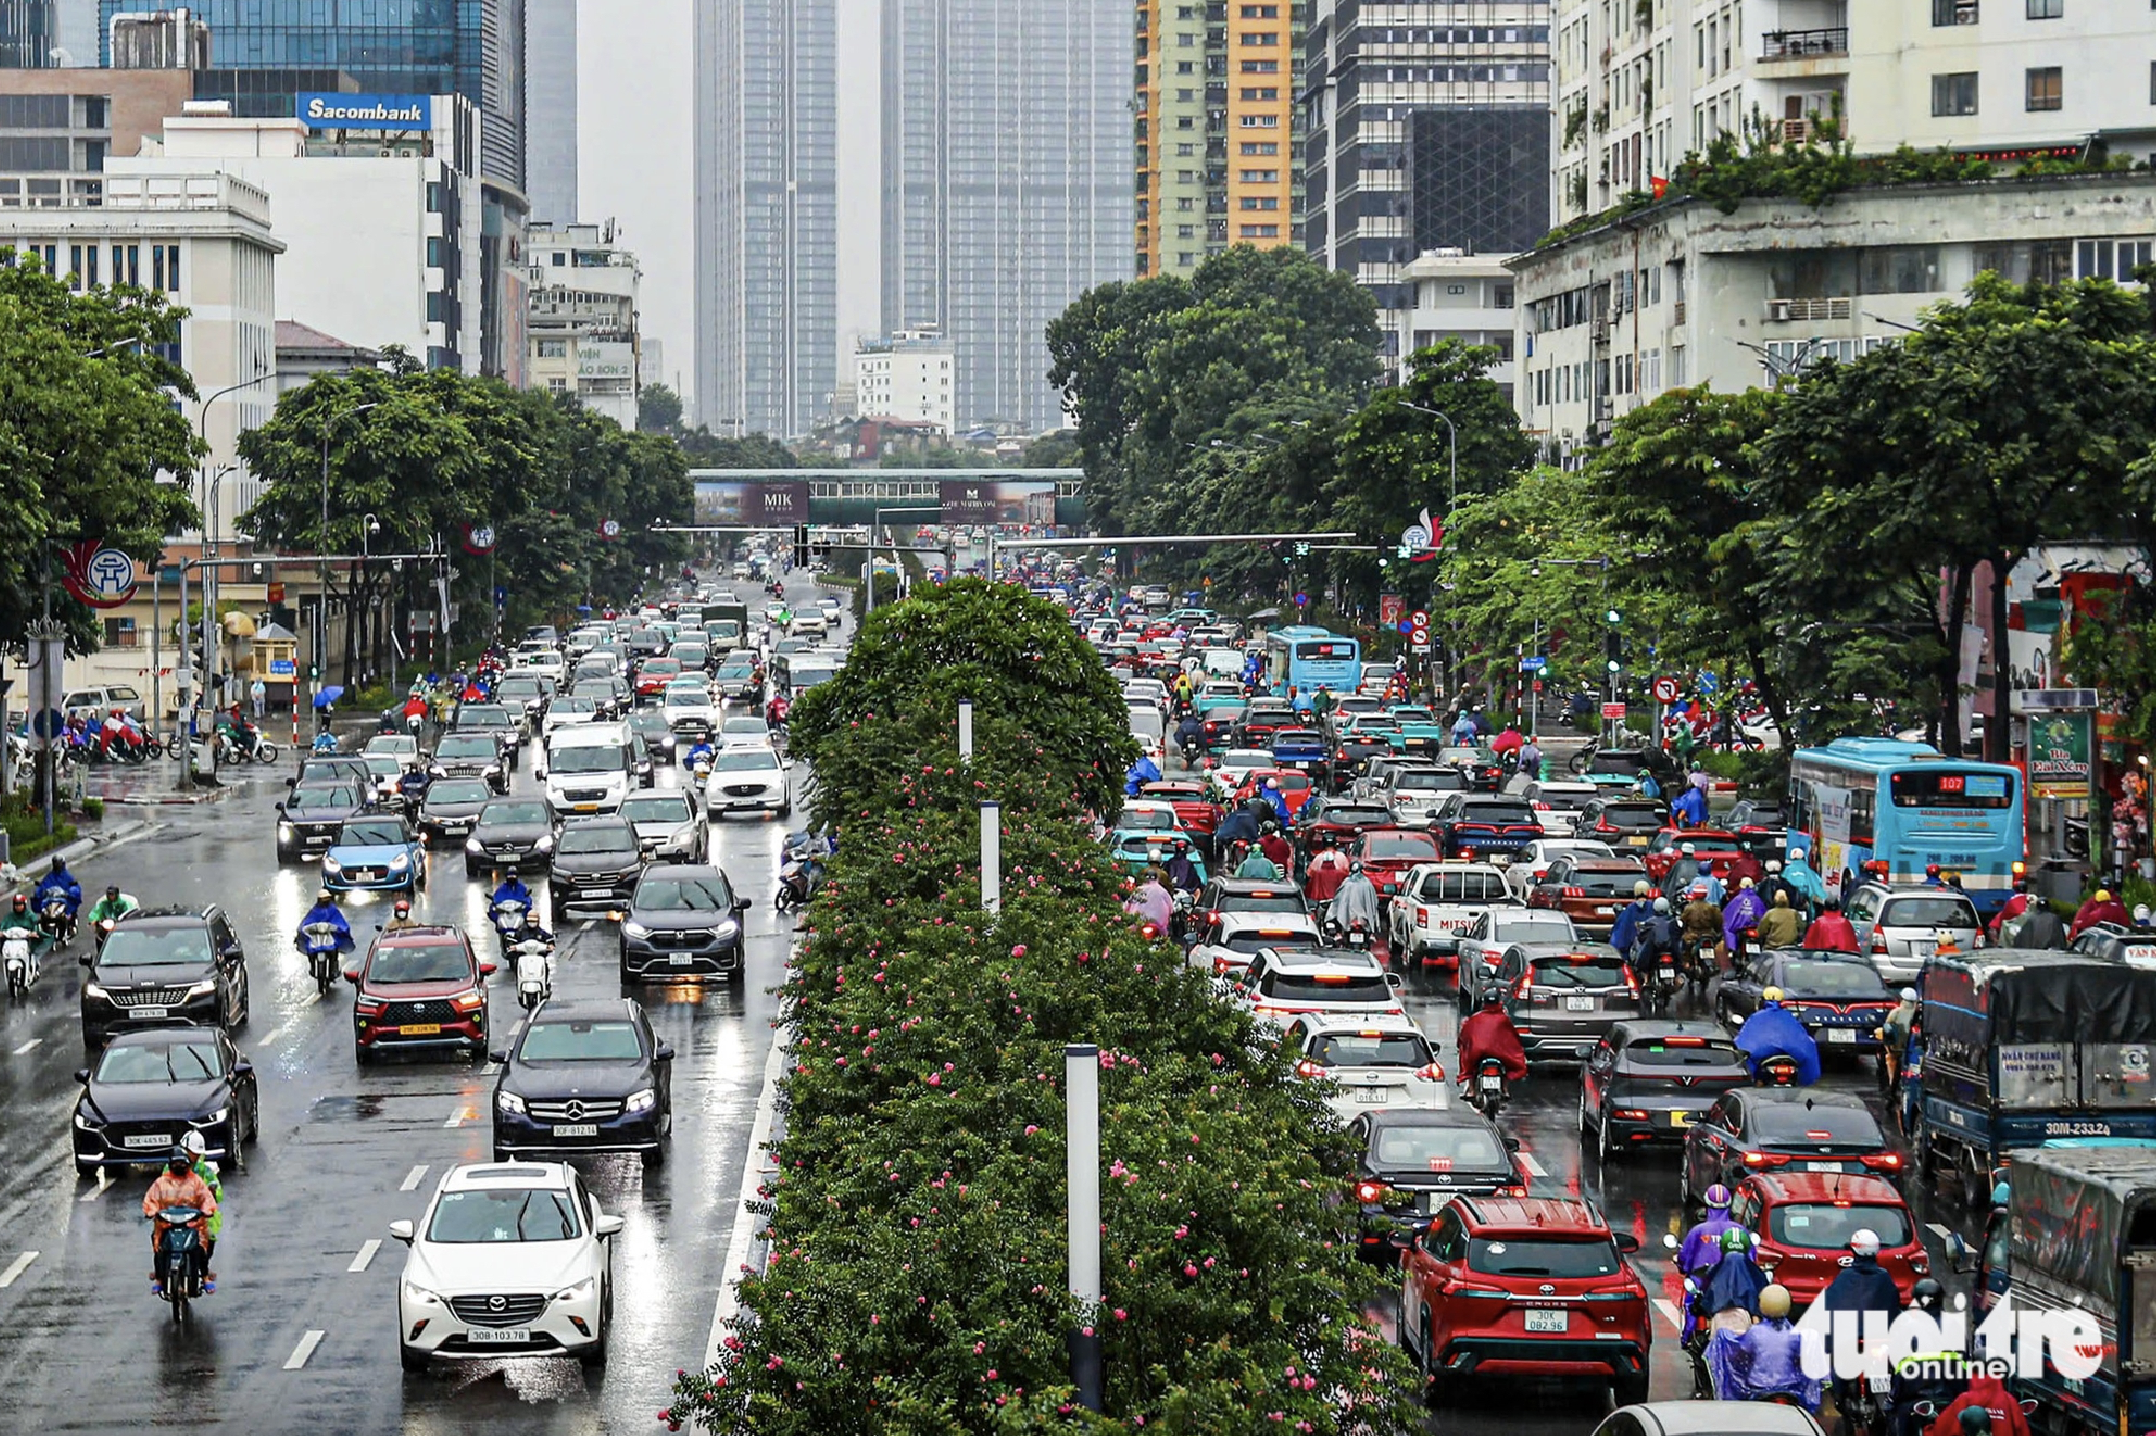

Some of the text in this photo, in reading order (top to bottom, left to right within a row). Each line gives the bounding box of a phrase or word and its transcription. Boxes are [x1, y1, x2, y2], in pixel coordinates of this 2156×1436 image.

[308, 98, 421, 120] Sacombank
[765, 494, 792, 506] MIK
[1943, 777, 1962, 789] 107
